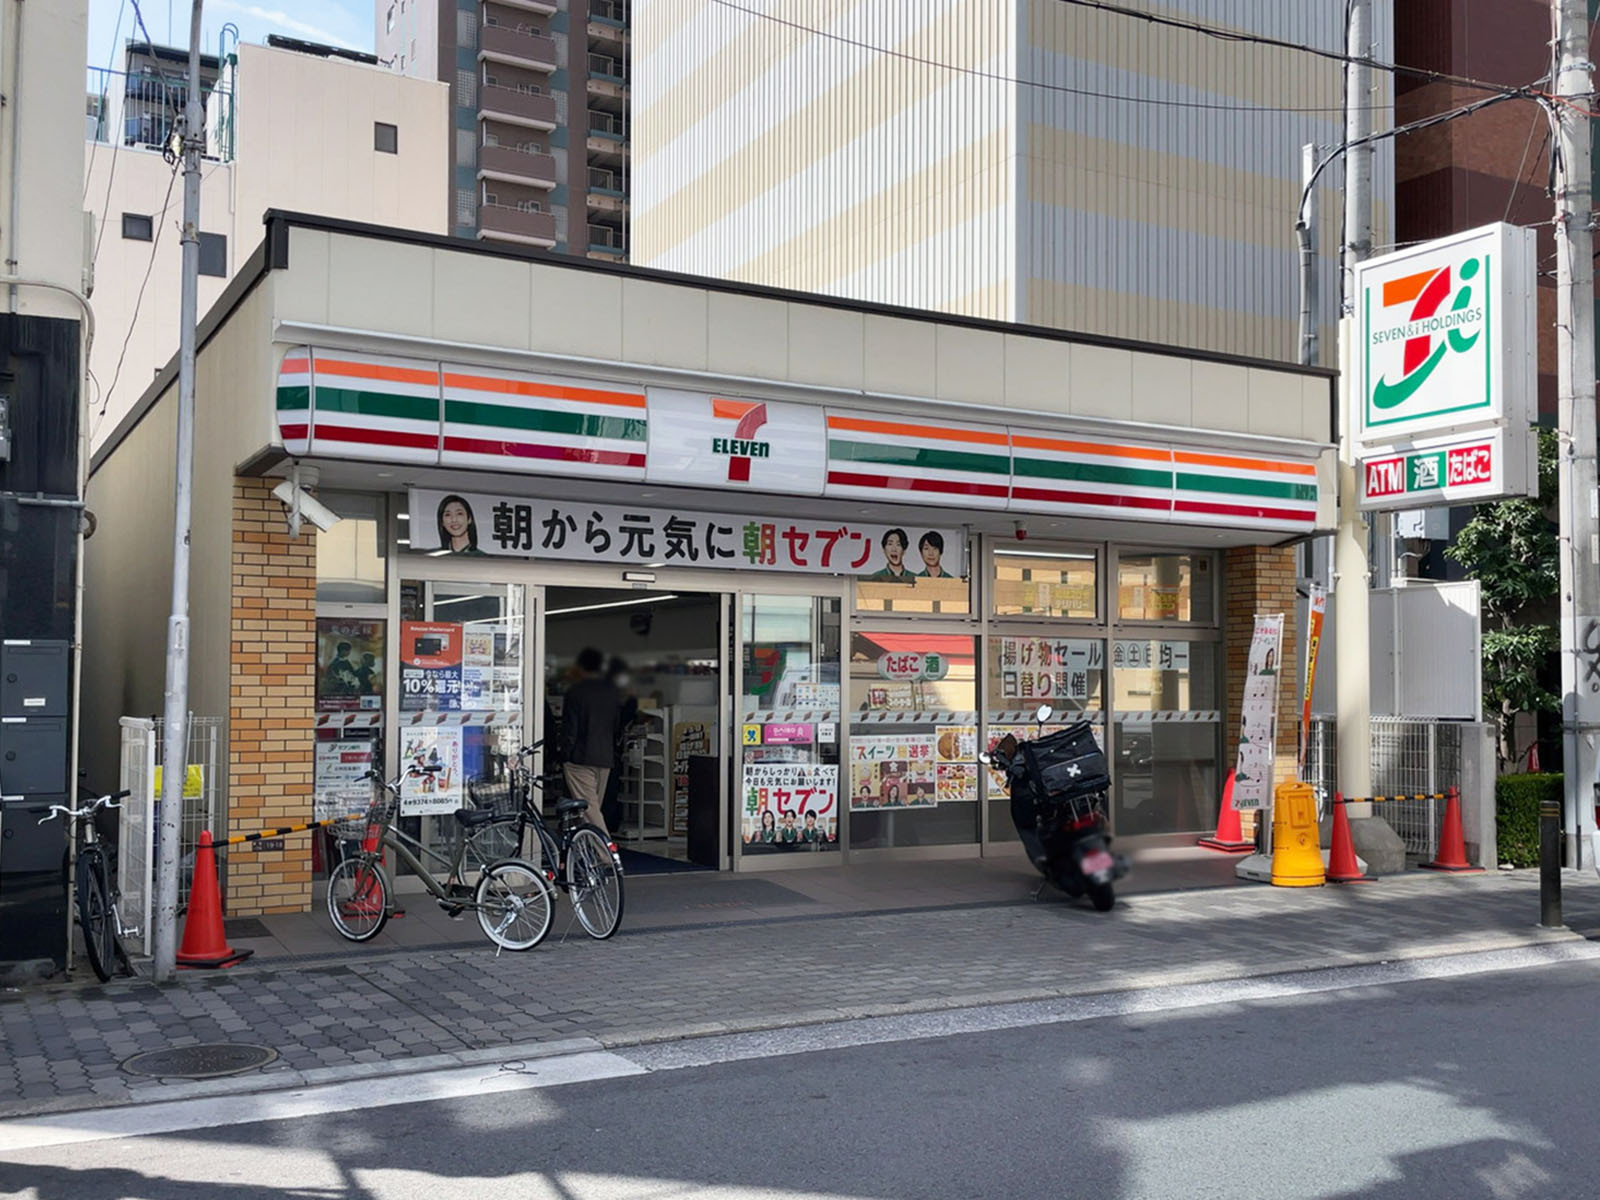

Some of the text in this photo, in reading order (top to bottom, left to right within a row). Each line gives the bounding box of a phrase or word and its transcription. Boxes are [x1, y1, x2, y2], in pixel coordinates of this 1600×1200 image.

[1422, 307, 1482, 332] HOLDINGS
[1367, 460, 1403, 495] ATM
[1413, 455, 1439, 489] 酒
[1449, 449, 1490, 483] たばこ
[492, 502, 872, 569] 朝から元気に朝セブン
[886, 655, 919, 673] たばこ
[925, 655, 940, 673] 酒
[1003, 640, 1101, 667] 揚げ物セール
[1003, 671, 1086, 697] 日替り開催
[746, 766, 836, 776] 朝からしっかり 食べて
[746, 786, 834, 817] 朝セブン
